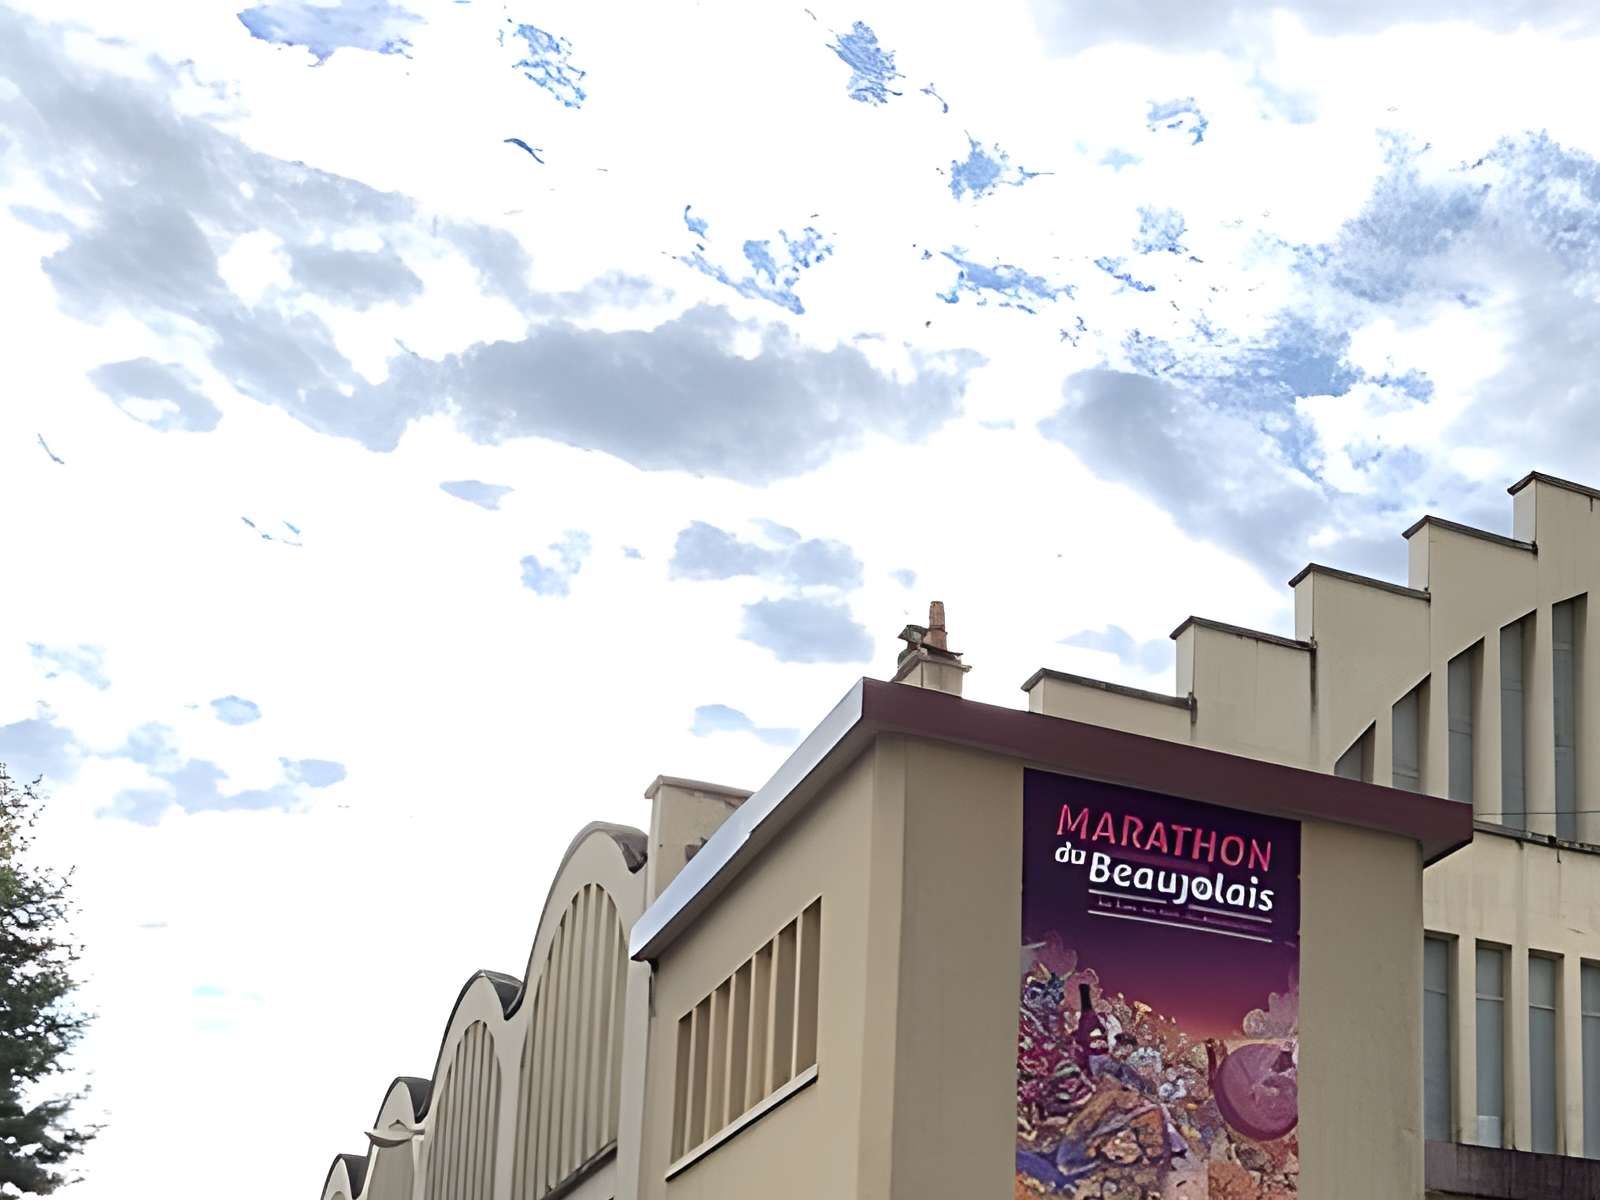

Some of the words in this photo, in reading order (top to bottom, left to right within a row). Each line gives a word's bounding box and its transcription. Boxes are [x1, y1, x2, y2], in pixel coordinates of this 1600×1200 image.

[1056, 803, 1272, 872] MARATHON
[1054, 841, 1086, 866] du
[1089, 851, 1275, 912] Beaujolais
